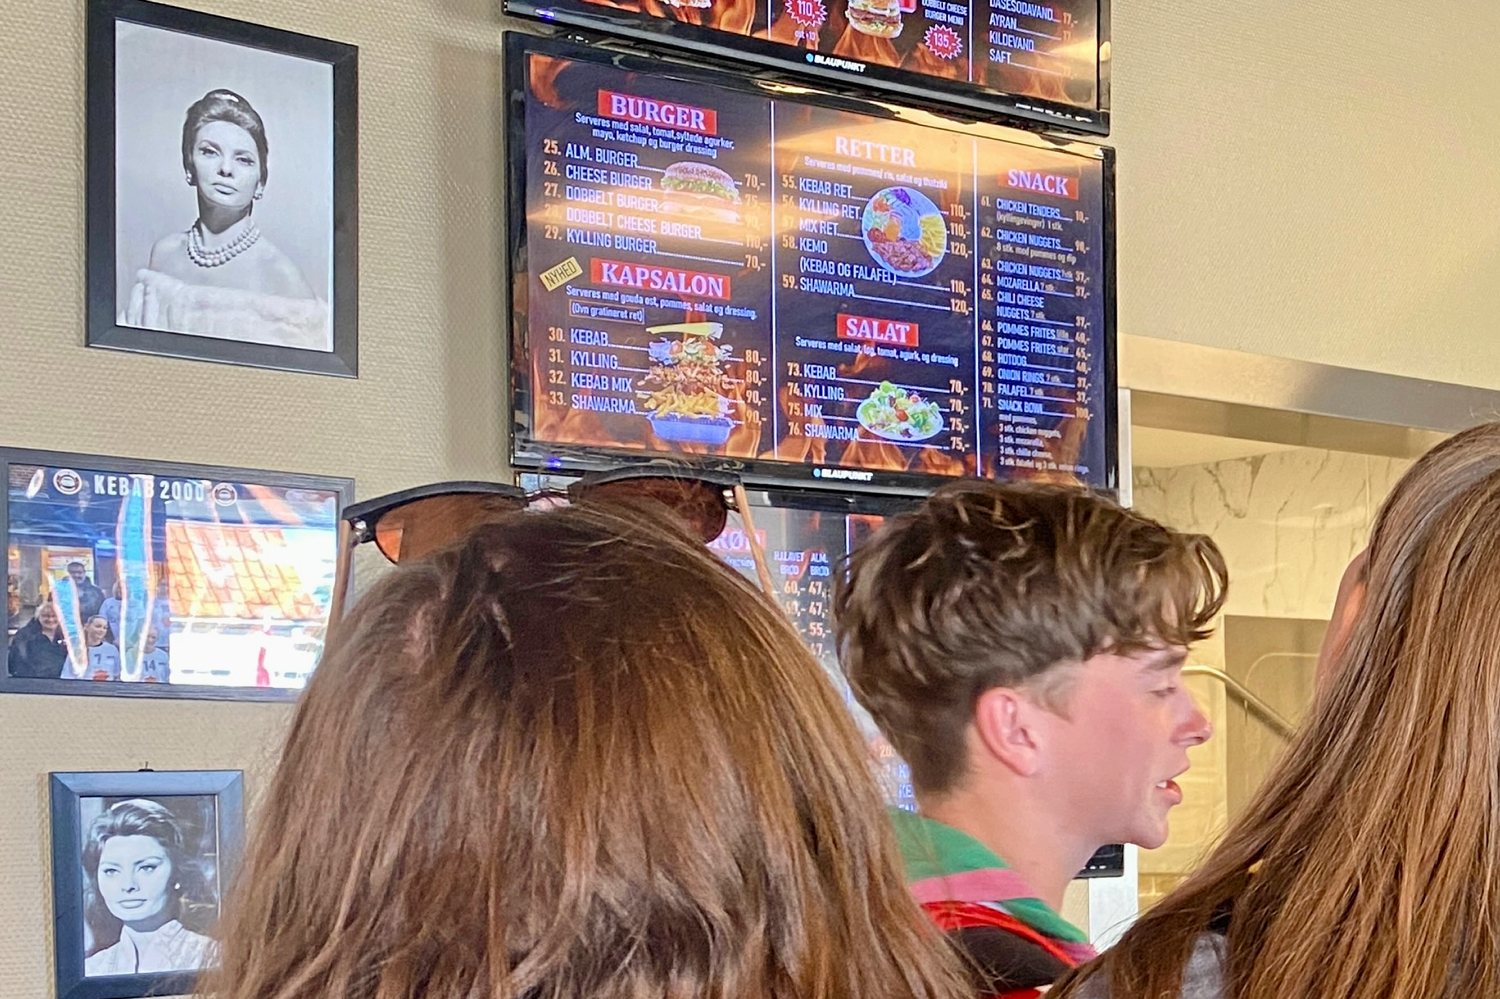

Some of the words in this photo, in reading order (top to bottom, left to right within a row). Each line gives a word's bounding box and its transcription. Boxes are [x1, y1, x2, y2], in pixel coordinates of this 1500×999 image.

[925, 11, 946, 22] BURGER
[948, 14, 963, 25] MENU
[947, 2, 968, 16] CHEESE
[989, 13, 1017, 29] AYRAN
[933, 32, 956, 48] 135,-
[989, 30, 1034, 51] KILDEVAND
[814, 55, 866, 73] BLAUPUNKT
[989, 48, 1011, 64] SAFT
[575, 112, 610, 127] Serveres
[612, 120, 628, 130] med
[611, 94, 706, 131] BURGER
[616, 131, 646, 147] ketchup
[649, 137, 657, 149] og
[659, 137, 684, 152] burger
[685, 143, 717, 159] dressing
[835, 135, 916, 168] RETTER
[544, 139, 561, 156] 25.
[565, 143, 593, 161] ALM.
[595, 147, 639, 168] BURGER
[745, 174, 766, 188] 70,-
[544, 161, 561, 177] 26.
[565, 165, 608, 185] CHEESE
[610, 171, 653, 190] BURGER
[1007, 169, 1069, 196] SNACK
[544, 182, 561, 199] 27.
[566, 186, 614, 207] DOBBELT
[616, 193, 659, 212] BURGER
[782, 175, 798, 190] 55.
[800, 177, 831, 195] KEBAB
[833, 183, 852, 199] RET
[950, 203, 971, 220] 110,-
[996, 198, 1028, 213] CHICKEN
[1028, 203, 1060, 219] TENDERS
[566, 207, 614, 228] DOBBELT
[617, 215, 657, 234] CHEESE
[660, 221, 702, 239] BURGER
[800, 197, 839, 217] KYLLING
[841, 205, 860, 220] RET
[950, 223, 971, 239] 110,-
[545, 225, 562, 241] 29.
[566, 228, 611, 248] KYLLING
[614, 236, 657, 255] BURGER
[745, 255, 766, 271] 70,-
[782, 234, 798, 249] 58.
[800, 237, 828, 254] KEMO
[800, 217, 818, 233] MIX
[819, 220, 839, 236] RET
[950, 242, 972, 259] 120,-
[996, 229, 1028, 244] CHICKEN
[1028, 234, 1061, 249] NUGGETS
[544, 260, 577, 286] NYHED
[601, 262, 724, 298] KAPSALON
[800, 257, 834, 276] (KEBAB
[837, 262, 851, 277] OG
[853, 265, 898, 286] FALAFEL)
[950, 280, 971, 295] 110,-
[996, 260, 1028, 275] CHICKEN
[1028, 265, 1061, 280] NUGGETS
[782, 275, 798, 289] 59.
[800, 276, 855, 297] SHAWARMA
[950, 299, 973, 316] 120,-
[996, 275, 1040, 292] MOZARELLA
[566, 285, 600, 298] Serveres
[602, 292, 619, 301] med
[621, 293, 643, 304] gouda
[694, 301, 712, 312] salat
[714, 305, 723, 316] og
[590, 304, 628, 319] gratineret
[997, 291, 1015, 305] CHILI
[1017, 295, 1045, 309] CHEESE
[997, 305, 1030, 320] NUGGETS
[846, 318, 910, 343] SALAT
[997, 322, 1029, 337] POMMES
[1030, 327, 1056, 340] FRITES
[549, 328, 566, 342] 30.
[570, 328, 609, 347] KEBAB
[745, 350, 767, 365] 80,-
[795, 336, 827, 349] Serveres
[827, 341, 843, 351] med
[921, 353, 930, 364] og
[931, 353, 958, 367] dressing
[997, 337, 1029, 352] POMMES
[1030, 342, 1056, 354] FRITES
[549, 349, 564, 363] 31.
[571, 350, 618, 369] KYLLING
[745, 370, 767, 387] 80,-
[997, 353, 1027, 367] HOTDOG
[549, 371, 566, 385] 32.
[571, 373, 609, 391] KEBAB
[612, 377, 632, 393] MIX
[746, 390, 767, 406] 90,-
[787, 362, 802, 377] 73.
[804, 364, 837, 380] KEBAB
[949, 380, 969, 396] 70,-
[998, 368, 1021, 382] ONION
[1022, 372, 1044, 384] RINGS
[787, 382, 802, 397] 74.
[804, 384, 844, 401] KYLLING
[949, 399, 969, 415] 70,-
[998, 384, 1029, 397] FALAFEL
[550, 392, 567, 406] 33.
[572, 394, 636, 414] SHAWARMA
[746, 410, 767, 426] 90,-
[788, 402, 802, 417] 75.
[804, 404, 823, 418] MIX
[950, 418, 969, 433] 75,-
[998, 399, 1023, 412] SNACK
[1024, 402, 1044, 414] BOWL
[788, 422, 802, 437] 76.
[805, 424, 860, 441] SHAWARMA
[950, 437, 970, 452] 75,-
[821, 468, 874, 481] BLAUPUNKT
[94, 475, 154, 499] KEBAB
[160, 480, 204, 501] 2000
